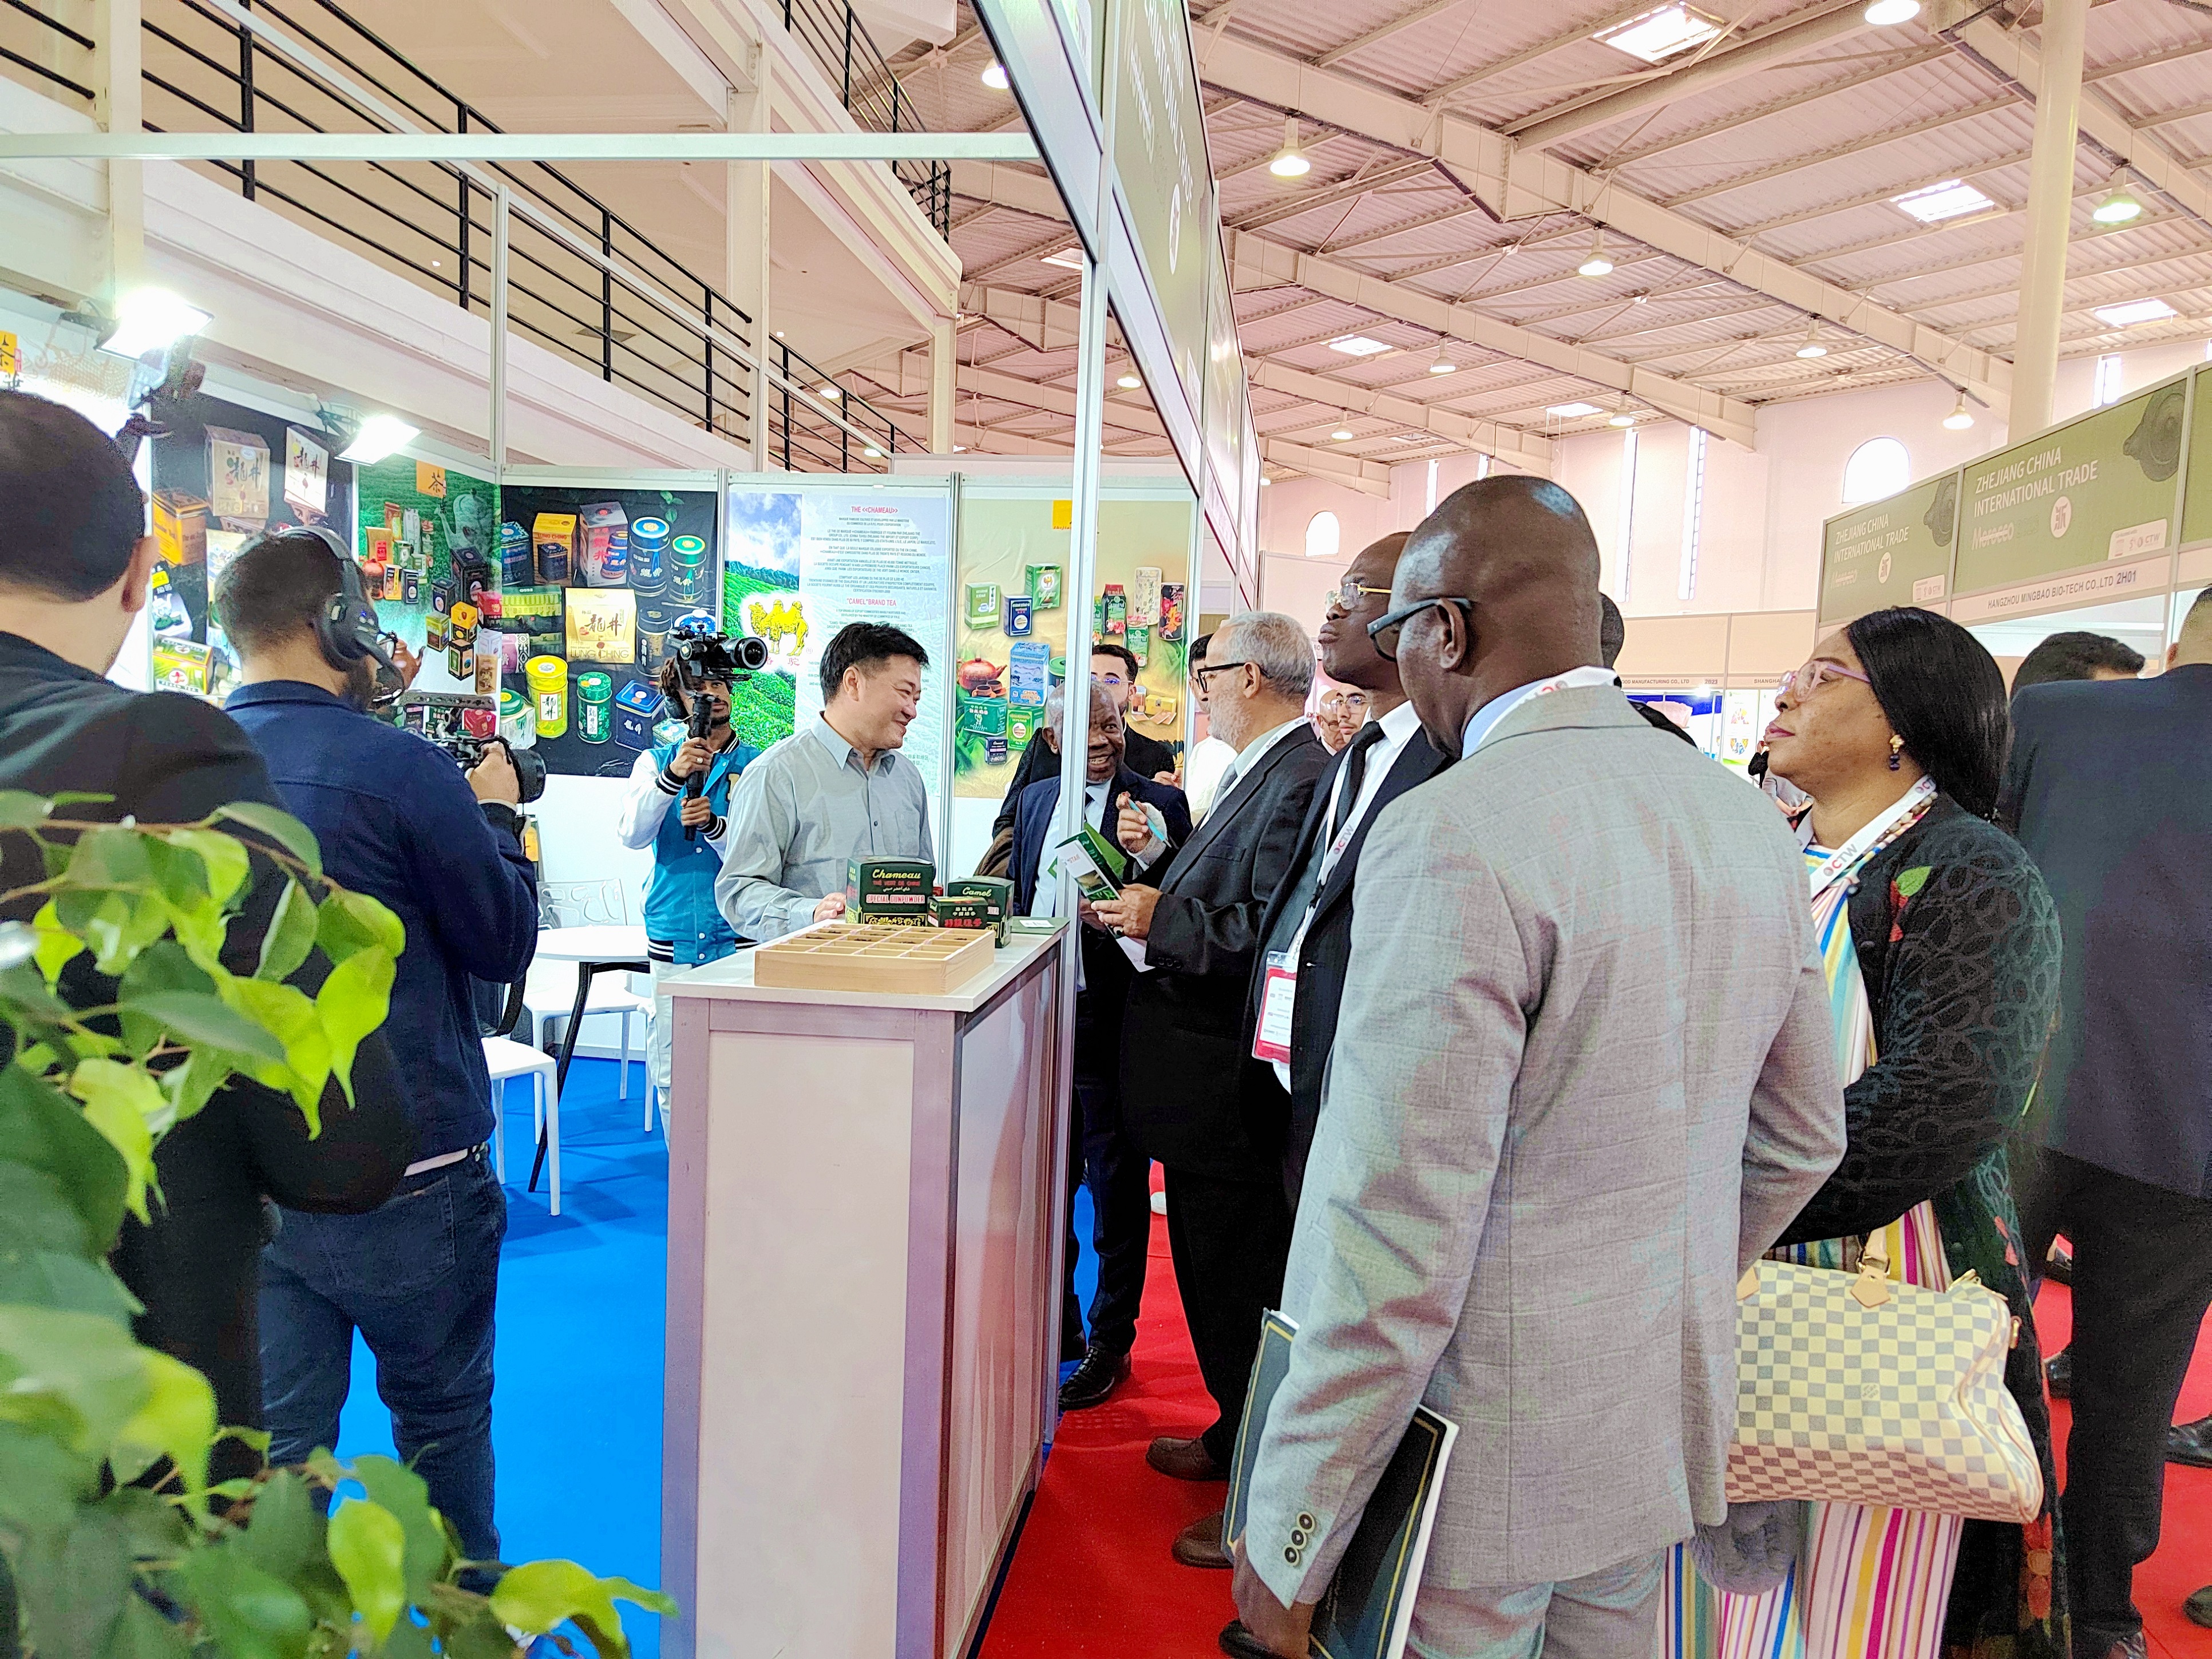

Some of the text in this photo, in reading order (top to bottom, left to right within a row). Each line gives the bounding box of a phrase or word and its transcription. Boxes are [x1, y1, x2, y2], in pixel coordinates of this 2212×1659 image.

[428, 470, 445, 493] 茶
[1976, 446, 2061, 494] ZHEJIANG CHINA
[1974, 460, 2099, 518] INTERNATIONAL TRADE
[1835, 513, 1889, 545] ZHEJIANG CHINA
[1834, 526, 1909, 564] INTERNATIONAL TRADE
[1988, 595, 2020, 609] HANGZHOU
[2021, 588, 2051, 603] MINGBAO
[2052, 580, 2084, 597] BIO-TECH
[2116, 569, 2136, 585] 2H01
[584, 613, 623, 636] 龍井
[571, 649, 629, 658] LUNG CHING
[1338, 824, 1354, 848] CTW
[1831, 843, 1858, 869] CTW
[872, 869, 921, 879] Chameau
[866, 894, 925, 904] SPECIAL GUNPOWDER
[962, 886, 992, 897] Camel
